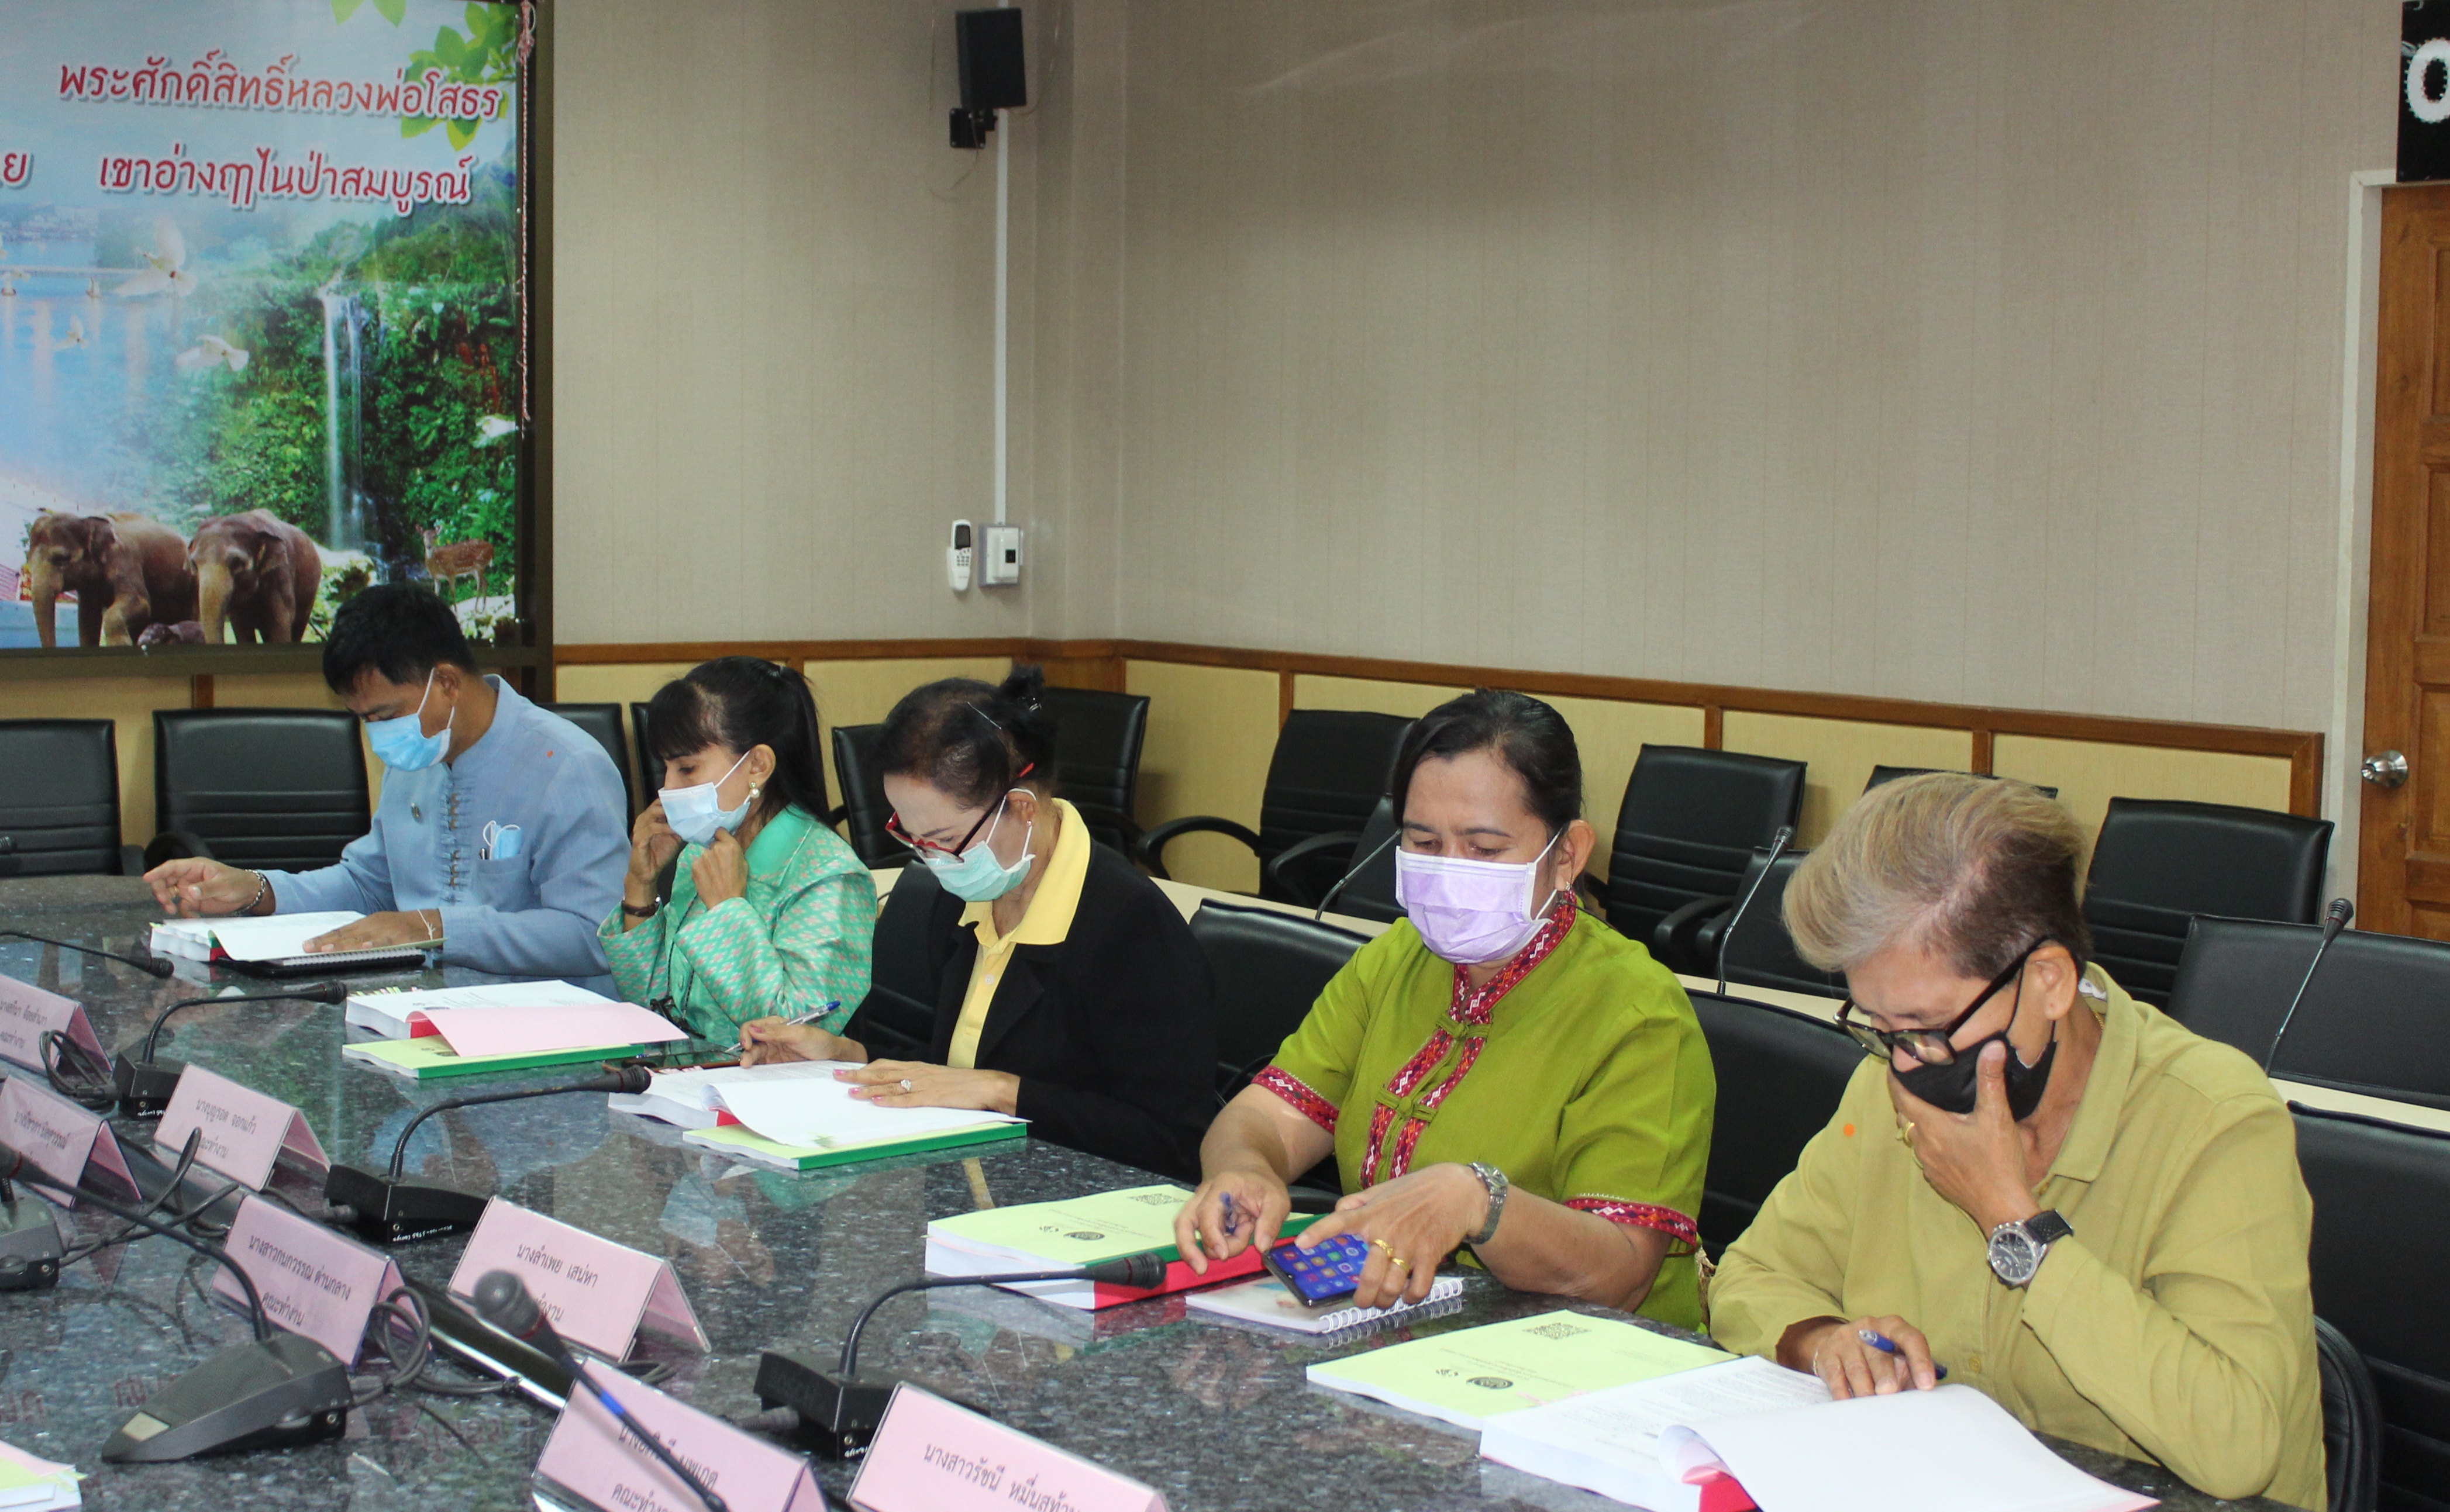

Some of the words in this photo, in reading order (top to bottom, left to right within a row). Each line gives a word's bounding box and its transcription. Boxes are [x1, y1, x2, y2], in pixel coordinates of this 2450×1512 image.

[59, 49, 501, 118] พระศักดิ์สิทธิ์หลวงพ่อโสธร
[566, 1263, 598, 1288] เสน่หา
[261, 1292, 305, 1327] คณะทำงาน
[924, 1443, 1005, 1492] นางสาวรัชนี
